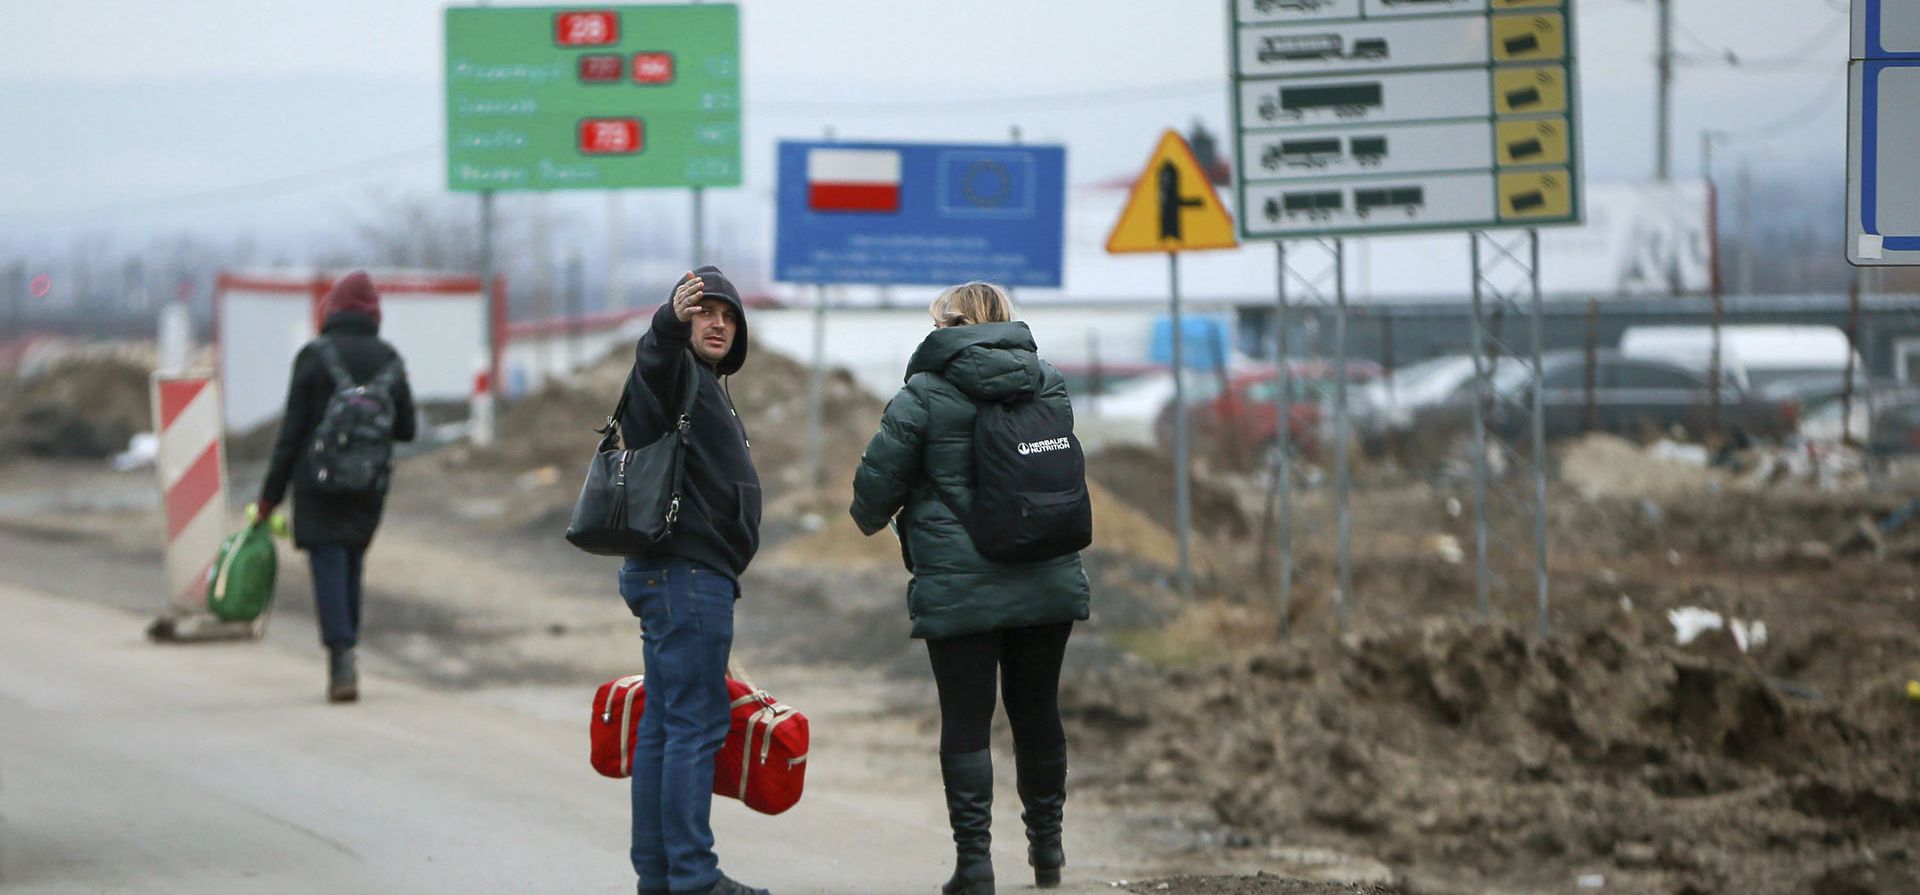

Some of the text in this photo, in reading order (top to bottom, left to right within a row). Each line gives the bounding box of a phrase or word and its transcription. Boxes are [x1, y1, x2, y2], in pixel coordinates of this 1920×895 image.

[568, 13, 607, 43] 28
[1029, 437, 1068, 448] HERBALIFE
[1030, 442, 1071, 453] NUTRITION
